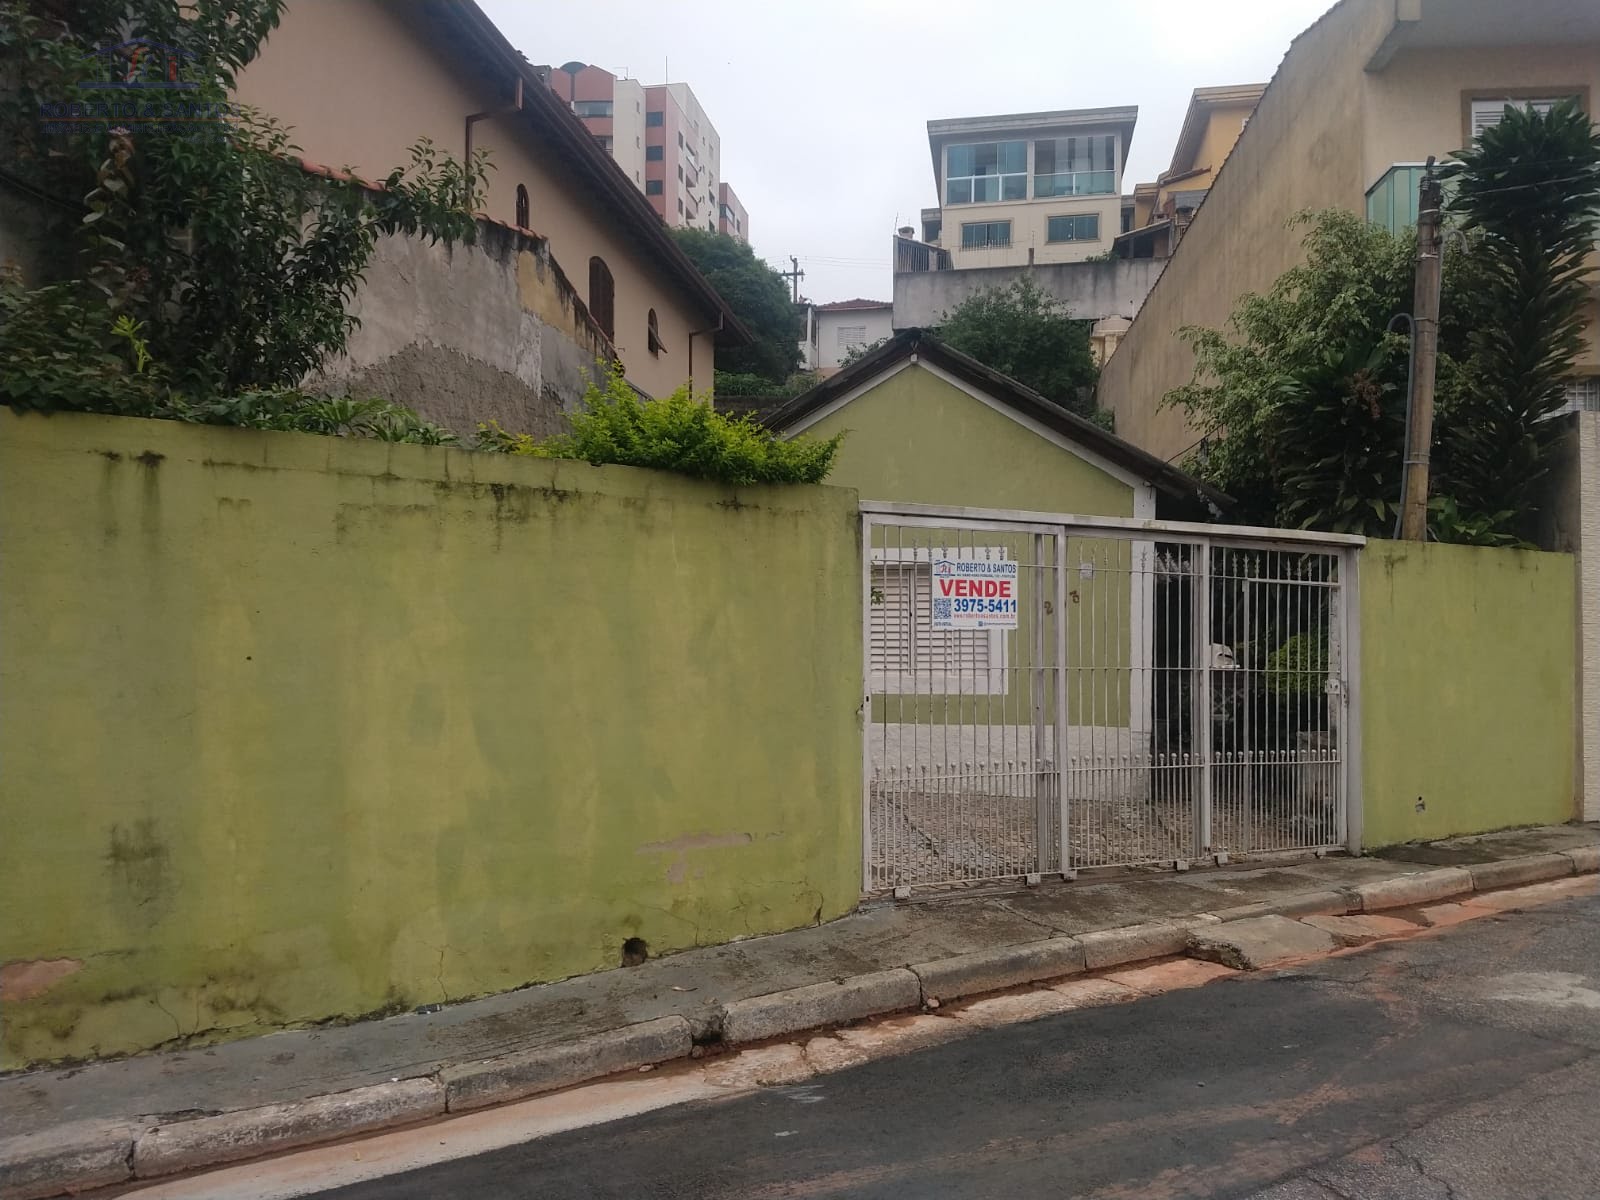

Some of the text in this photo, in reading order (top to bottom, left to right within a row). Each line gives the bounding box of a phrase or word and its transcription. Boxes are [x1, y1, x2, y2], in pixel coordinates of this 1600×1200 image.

[956, 562, 1016, 574] ROBERTO & SANTOS
[939, 579, 1011, 598] VENDE
[953, 598, 1016, 613] 3975-5411
